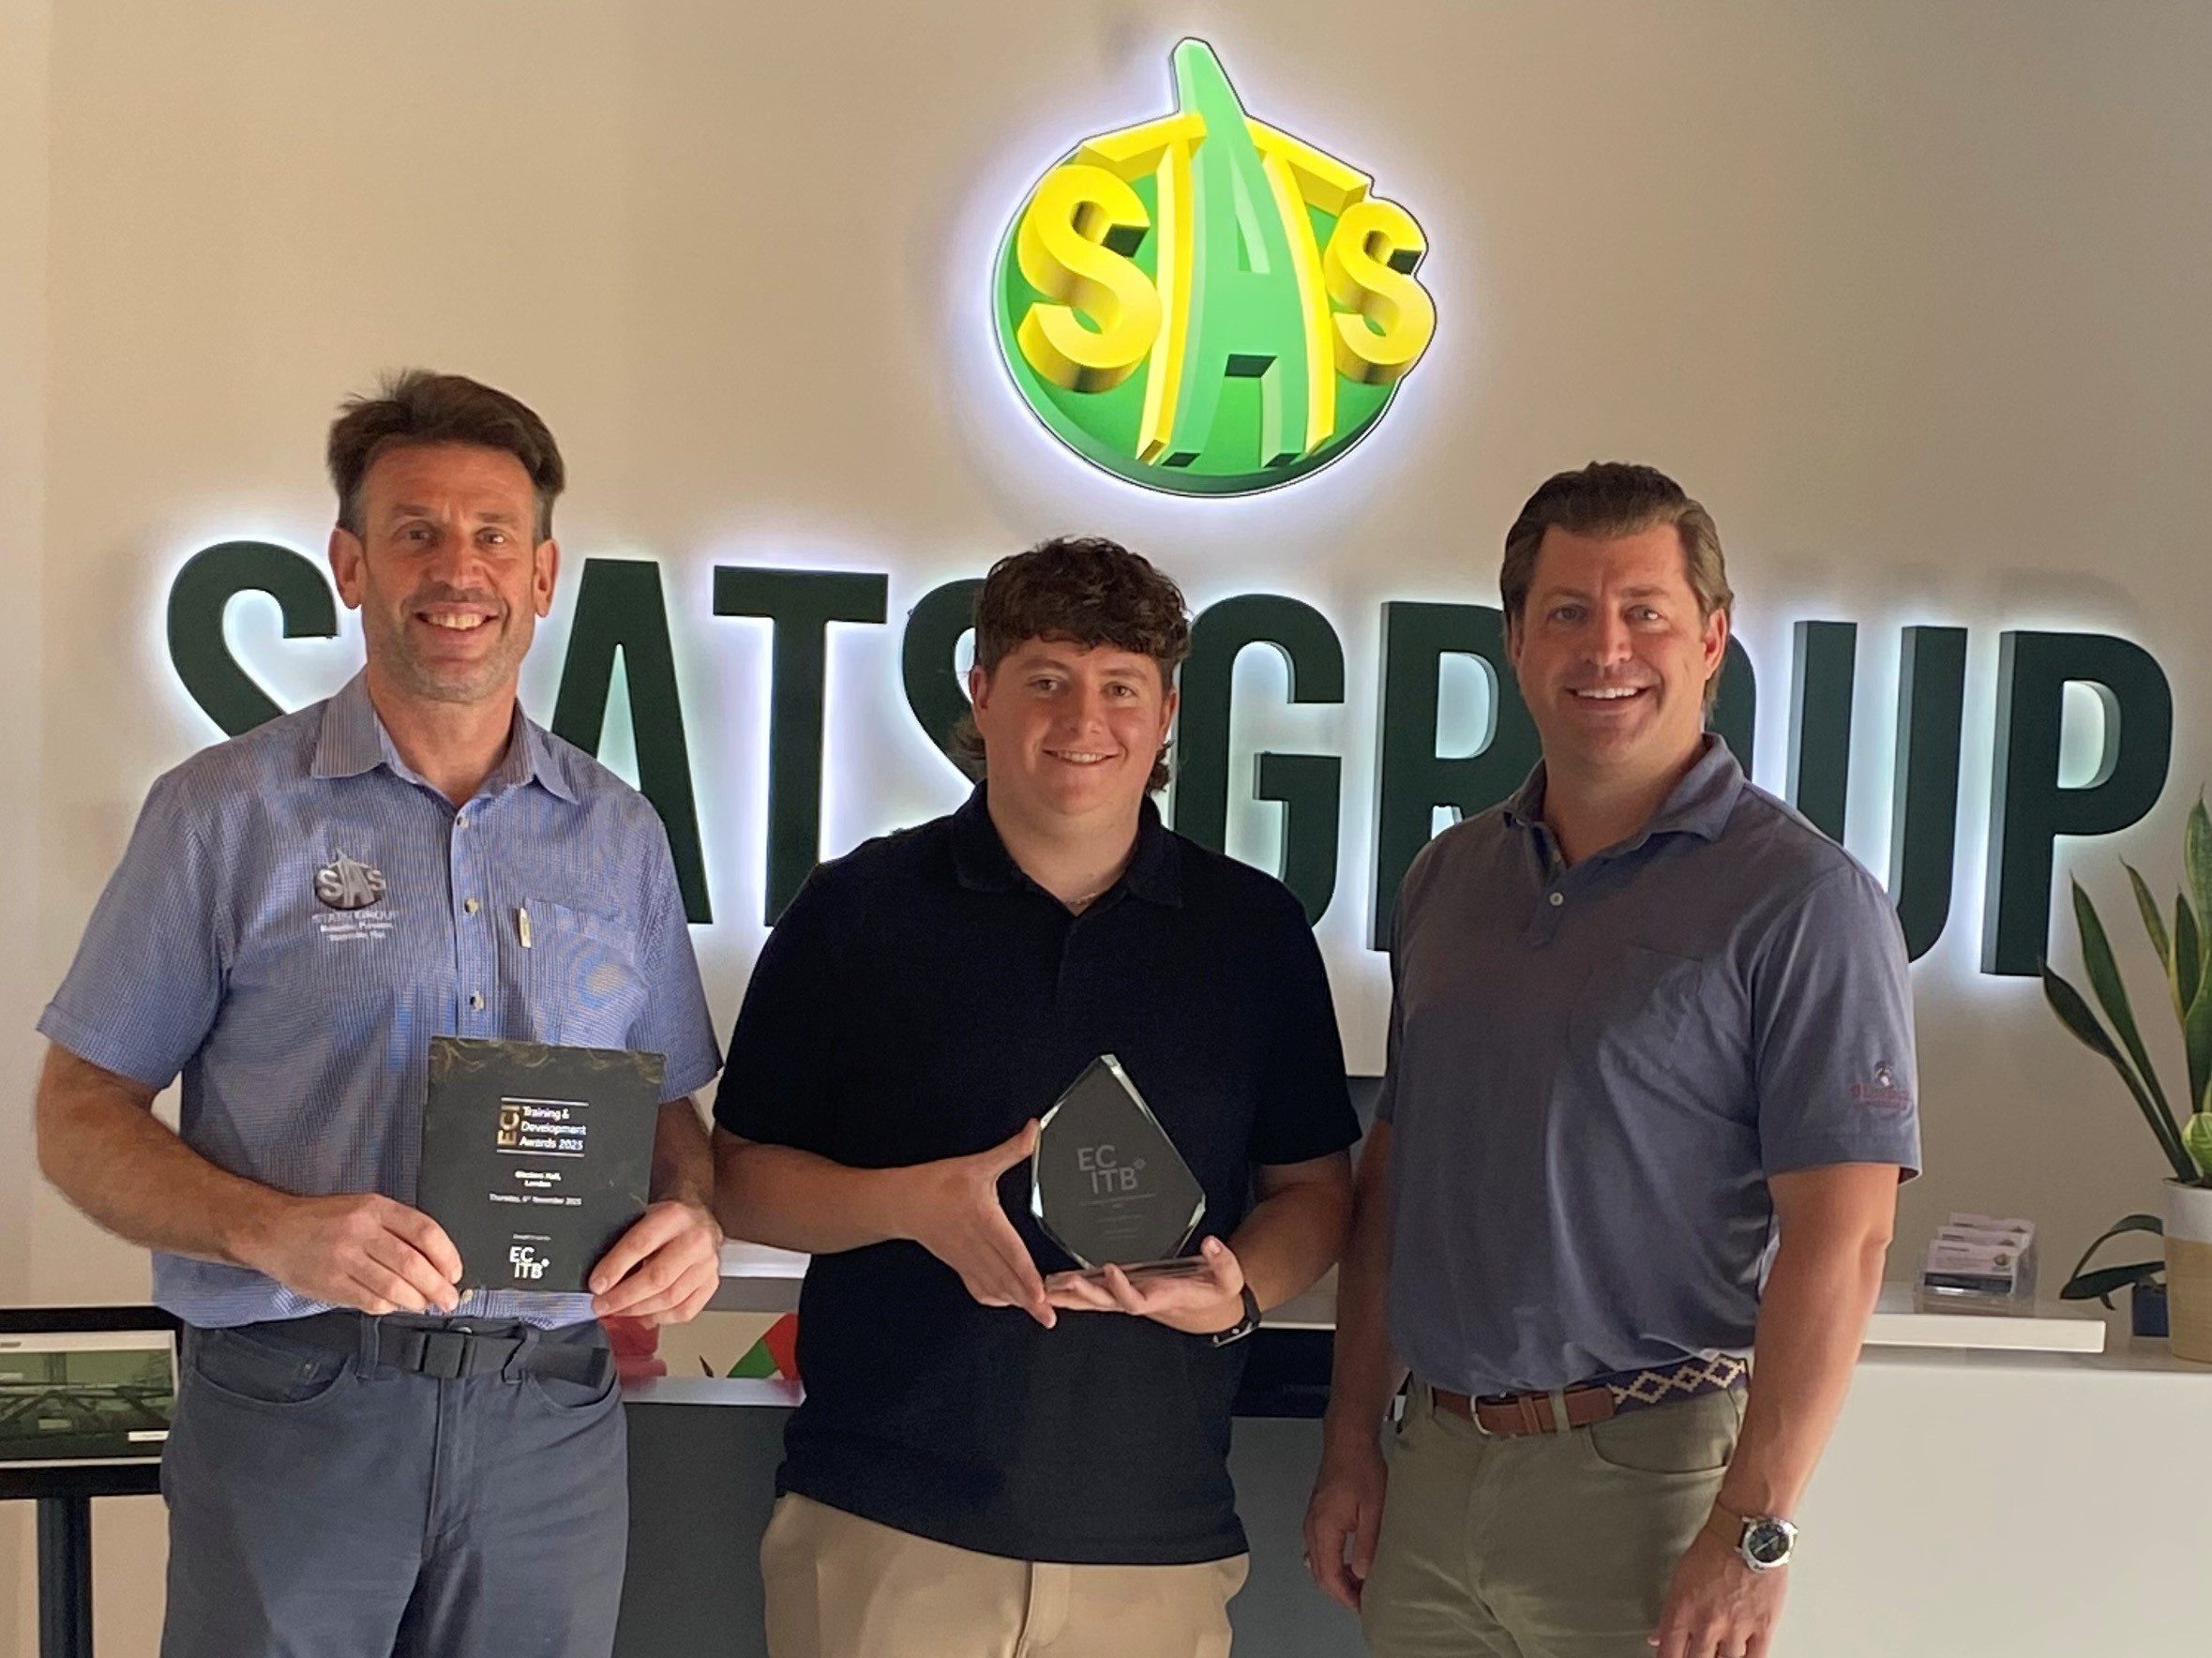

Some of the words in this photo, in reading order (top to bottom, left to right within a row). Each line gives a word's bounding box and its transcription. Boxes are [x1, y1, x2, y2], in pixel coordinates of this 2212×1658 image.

[1171, 593, 2174, 977] GRUP
[522, 1106, 562, 1123] Training
[562, 1108, 571, 1121] &
[497, 1105, 521, 1145] ECI
[520, 1121, 588, 1137] Development
[519, 1136, 557, 1150] Awards
[1077, 1145, 1117, 1171] EC
[1091, 1168, 1137, 1195] ITB
[509, 1246, 535, 1263] EC
[514, 1261, 543, 1279] ITB
